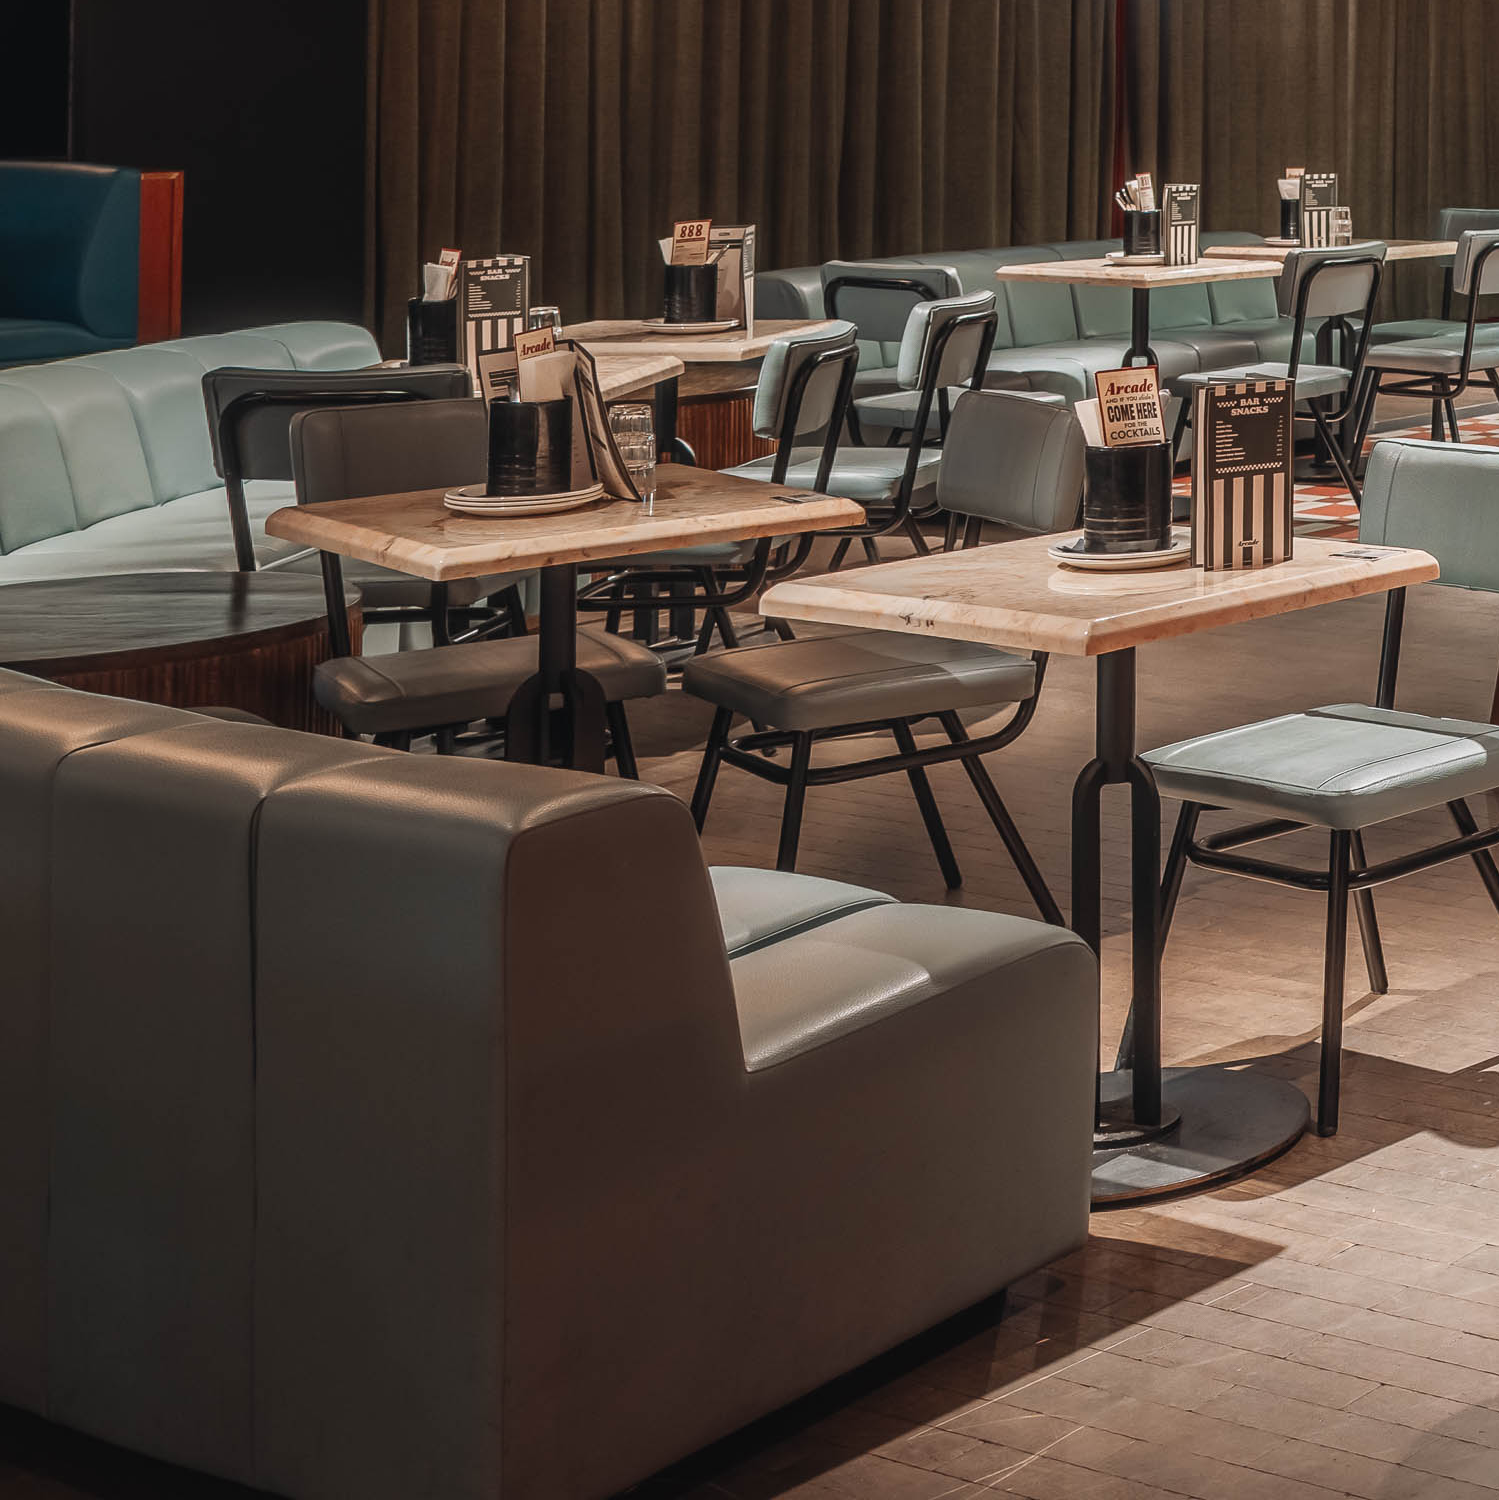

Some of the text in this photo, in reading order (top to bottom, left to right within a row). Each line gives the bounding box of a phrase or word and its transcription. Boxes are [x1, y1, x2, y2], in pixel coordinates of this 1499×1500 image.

[680, 224, 703, 238] 888
[520, 338, 552, 356] Arcade
[1104, 378, 1153, 396] Arcade
[1240, 398, 1260, 406] BAR
[1107, 402, 1158, 423] COME HERE
[1231, 406, 1268, 416] SNACKS
[1110, 426, 1160, 440] COCKTAILS
